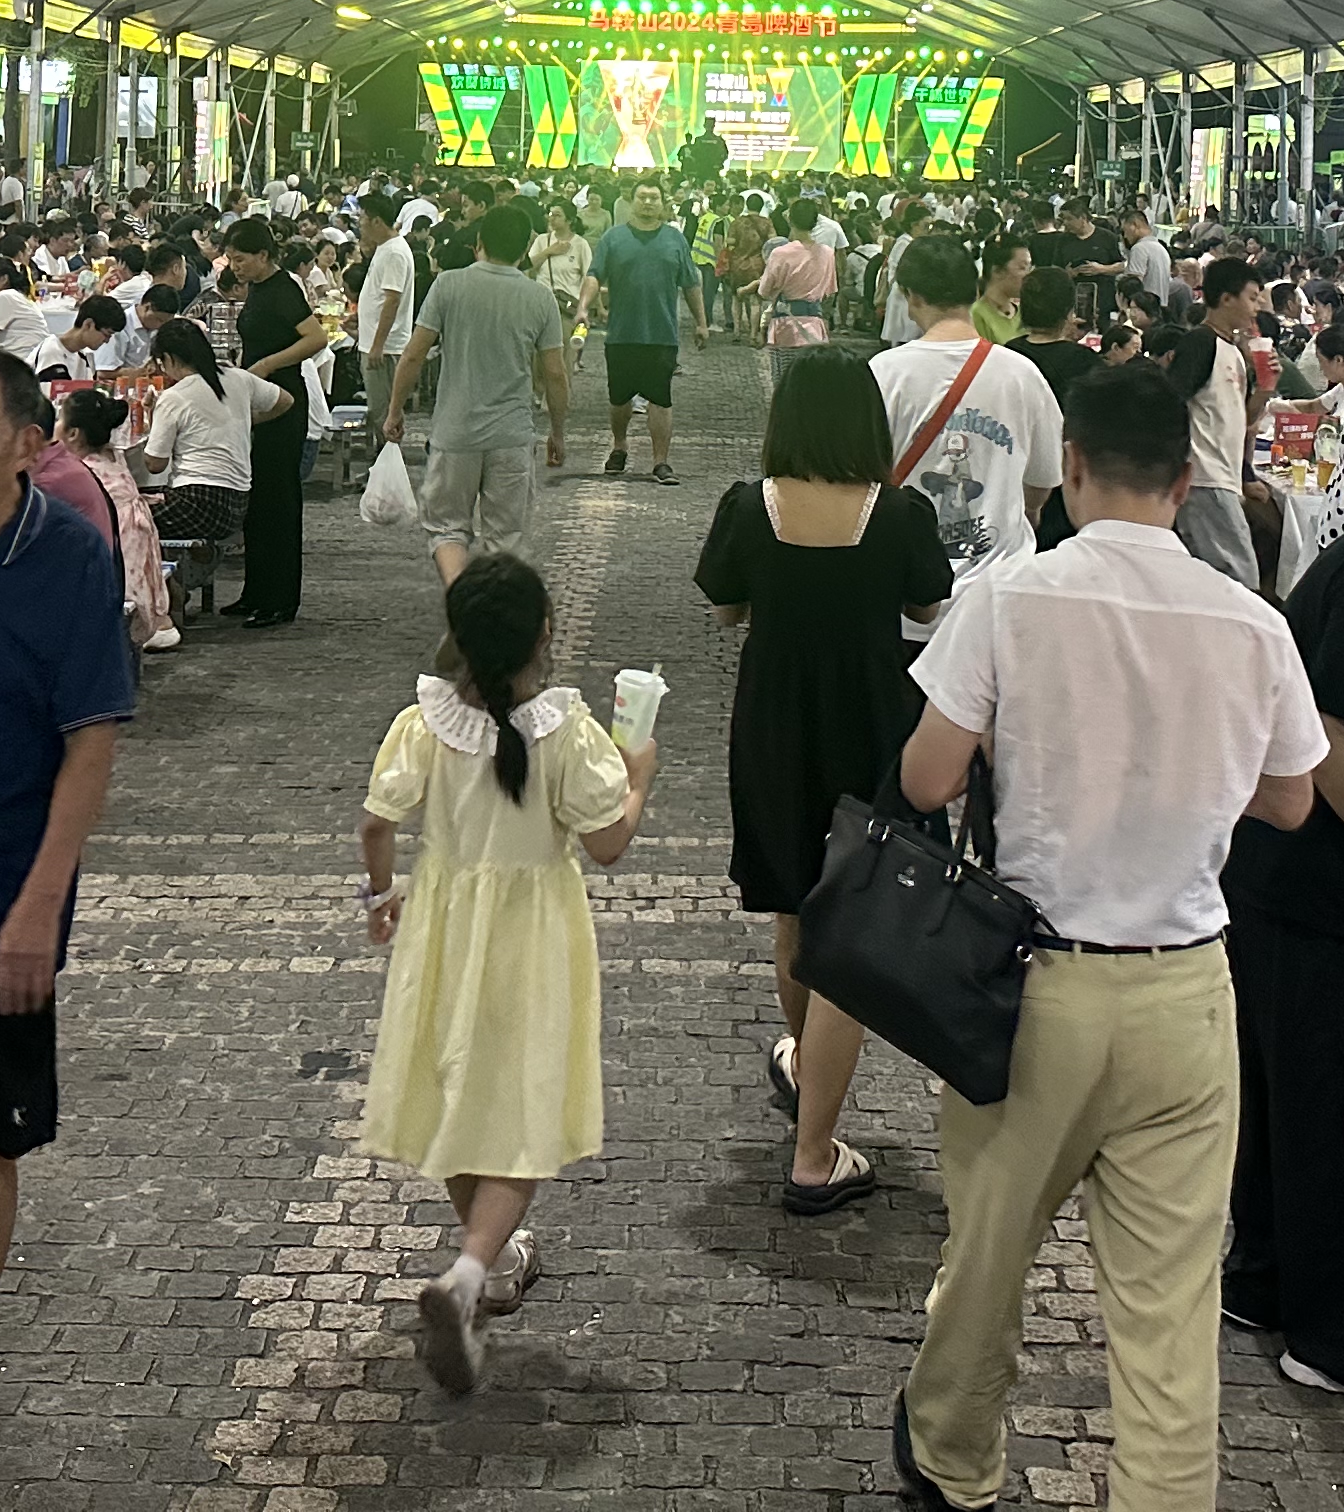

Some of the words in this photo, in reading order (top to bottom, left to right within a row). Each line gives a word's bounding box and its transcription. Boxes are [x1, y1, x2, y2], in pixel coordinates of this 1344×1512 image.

[587, 8, 837, 37] 马鞍山2024青岛啤酒节
